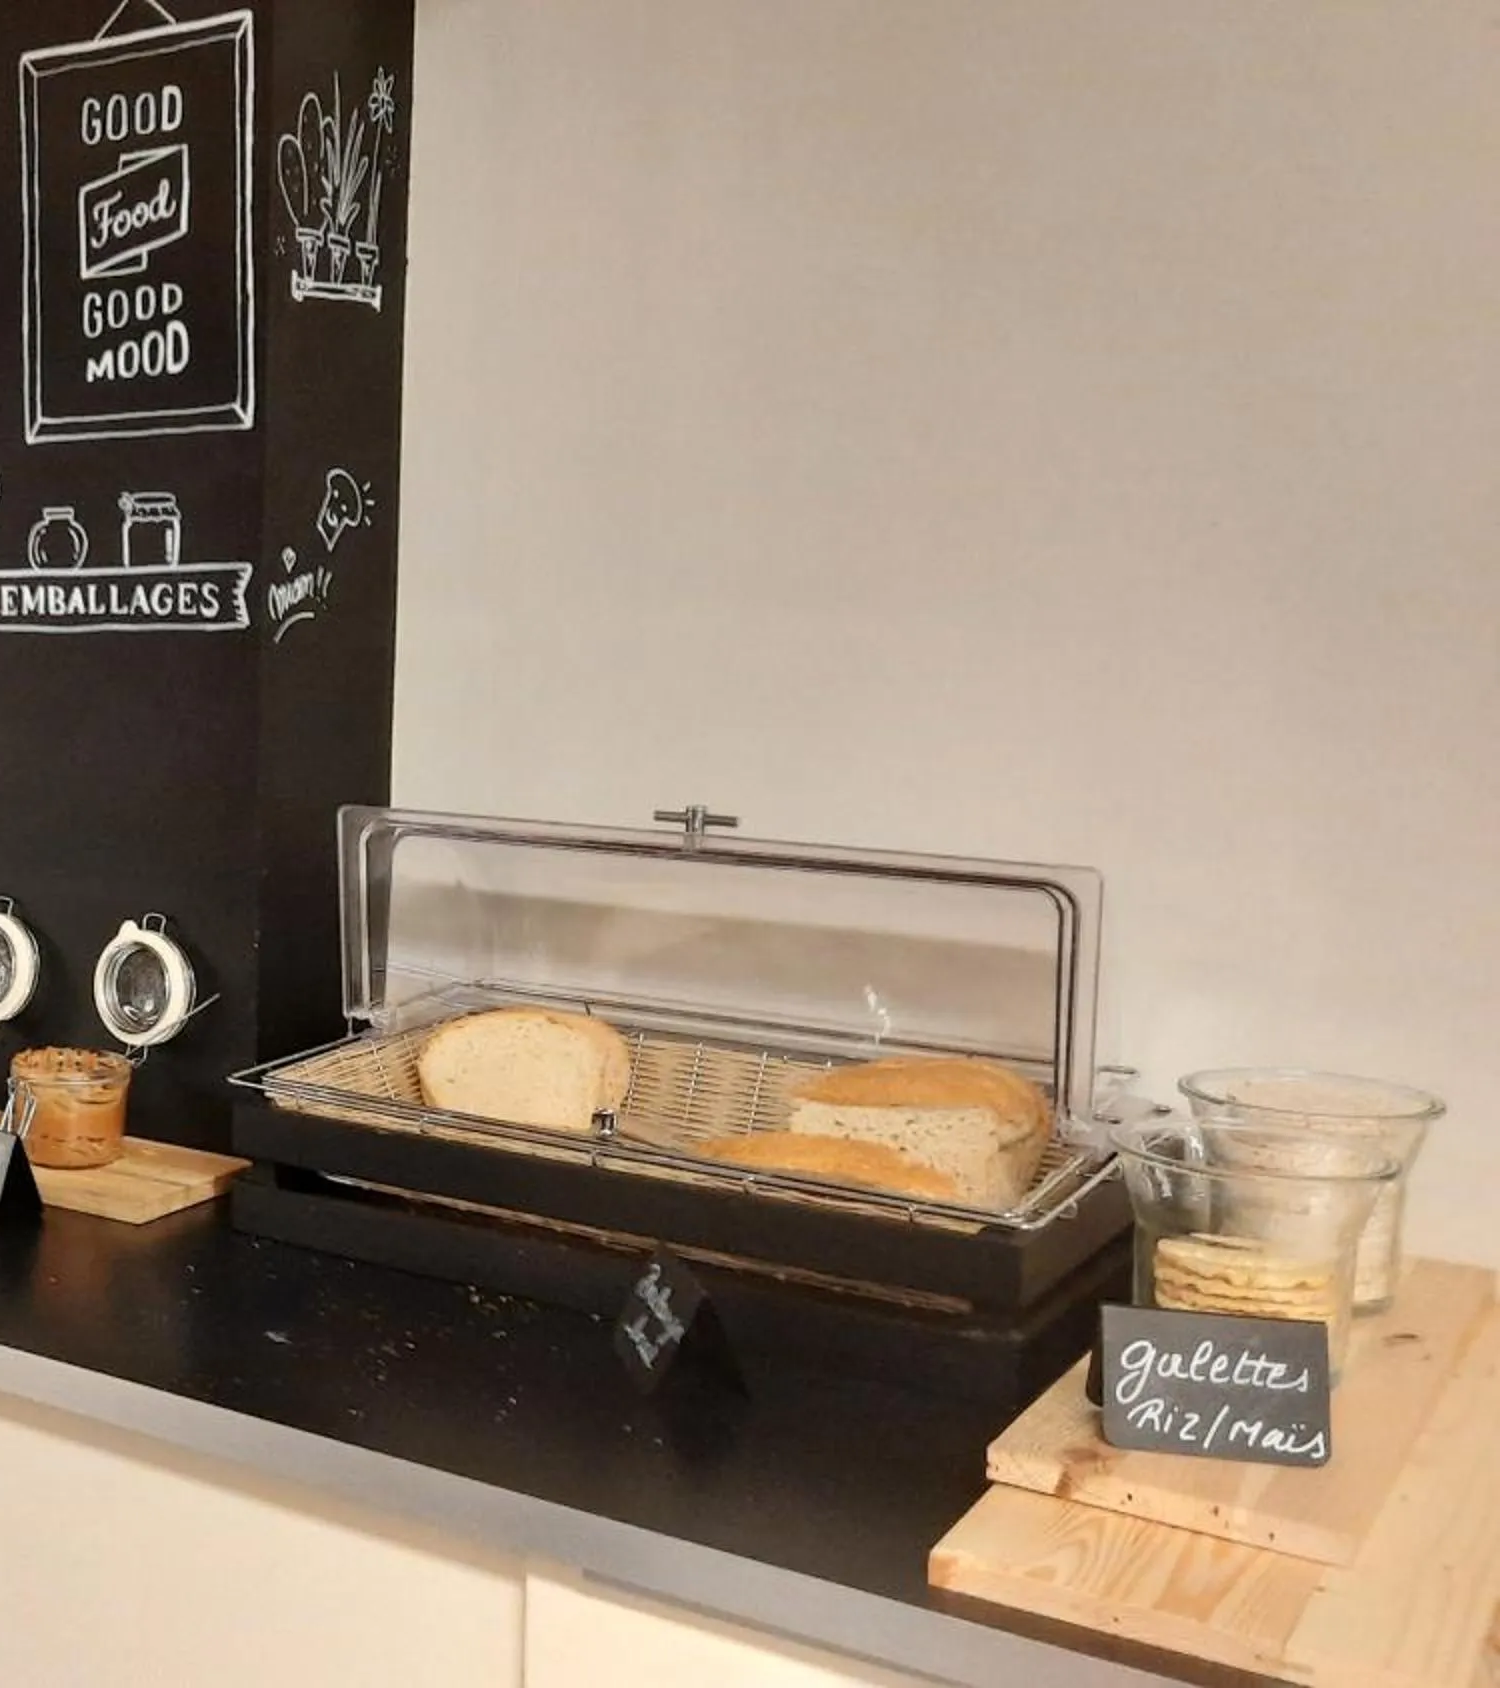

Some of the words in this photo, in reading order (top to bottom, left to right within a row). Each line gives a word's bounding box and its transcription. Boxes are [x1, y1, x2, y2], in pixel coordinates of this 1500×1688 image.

[81, 85, 183, 145] GOOD
[91, 178, 177, 249] Food
[83, 283, 183, 339] GOOD
[86, 320, 190, 383] MOOD
[0, 582, 221, 618] EMBALLAGES
